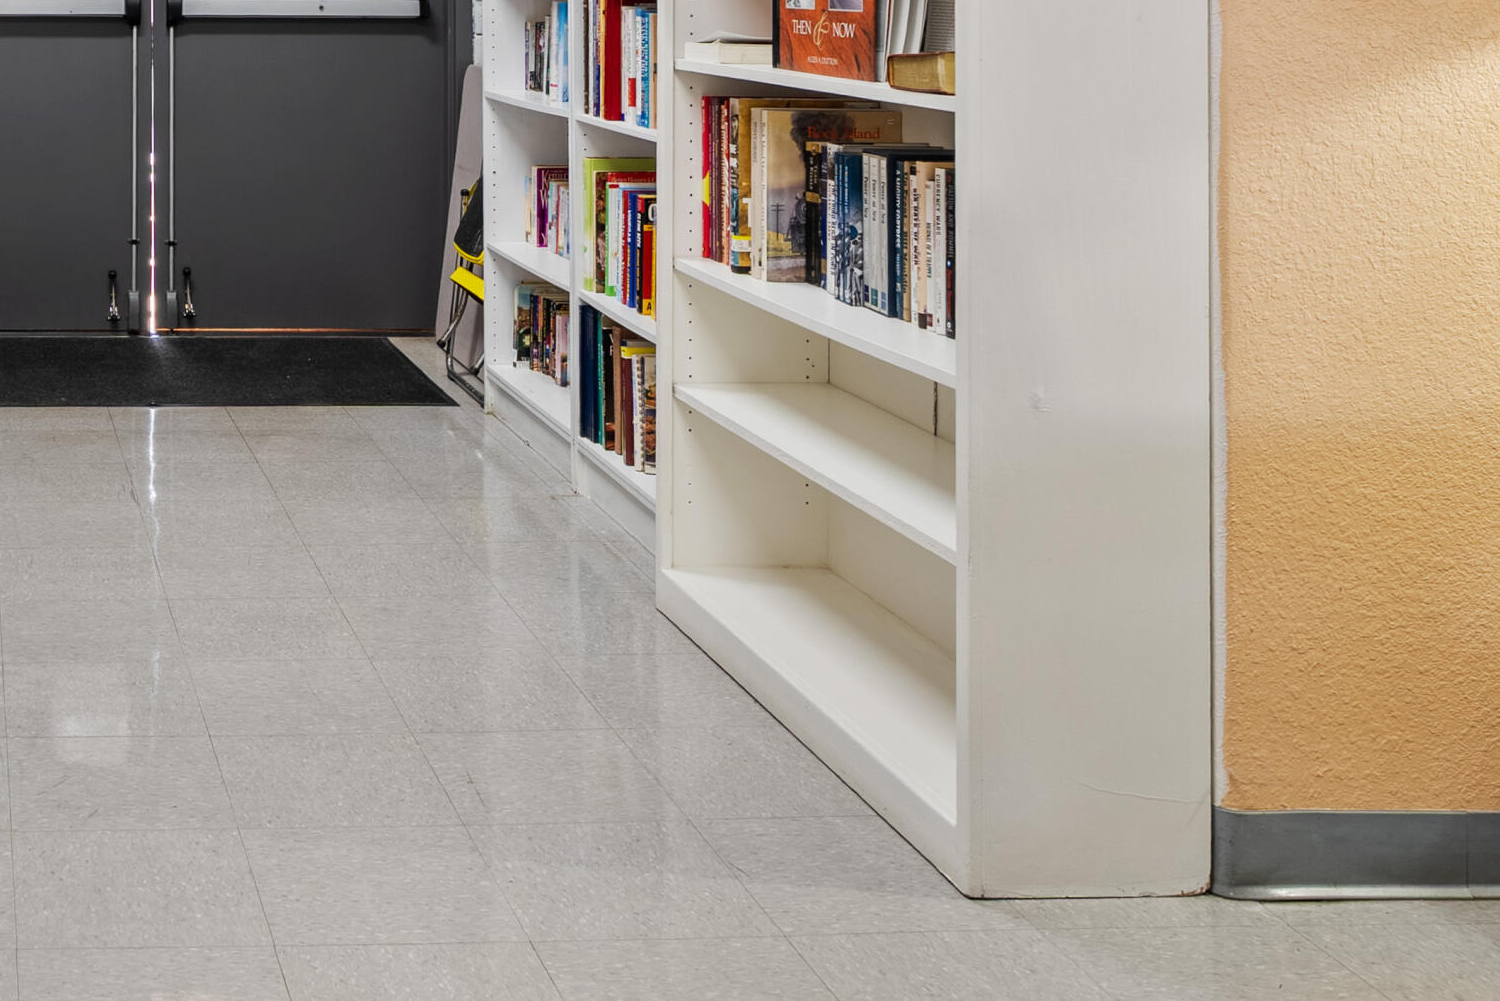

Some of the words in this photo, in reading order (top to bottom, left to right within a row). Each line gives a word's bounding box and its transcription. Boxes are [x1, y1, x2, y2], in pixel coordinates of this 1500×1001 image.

[792, 19, 812, 35] THEN
[812, 11, 831, 51] &
[832, 23, 856, 38] NOW
